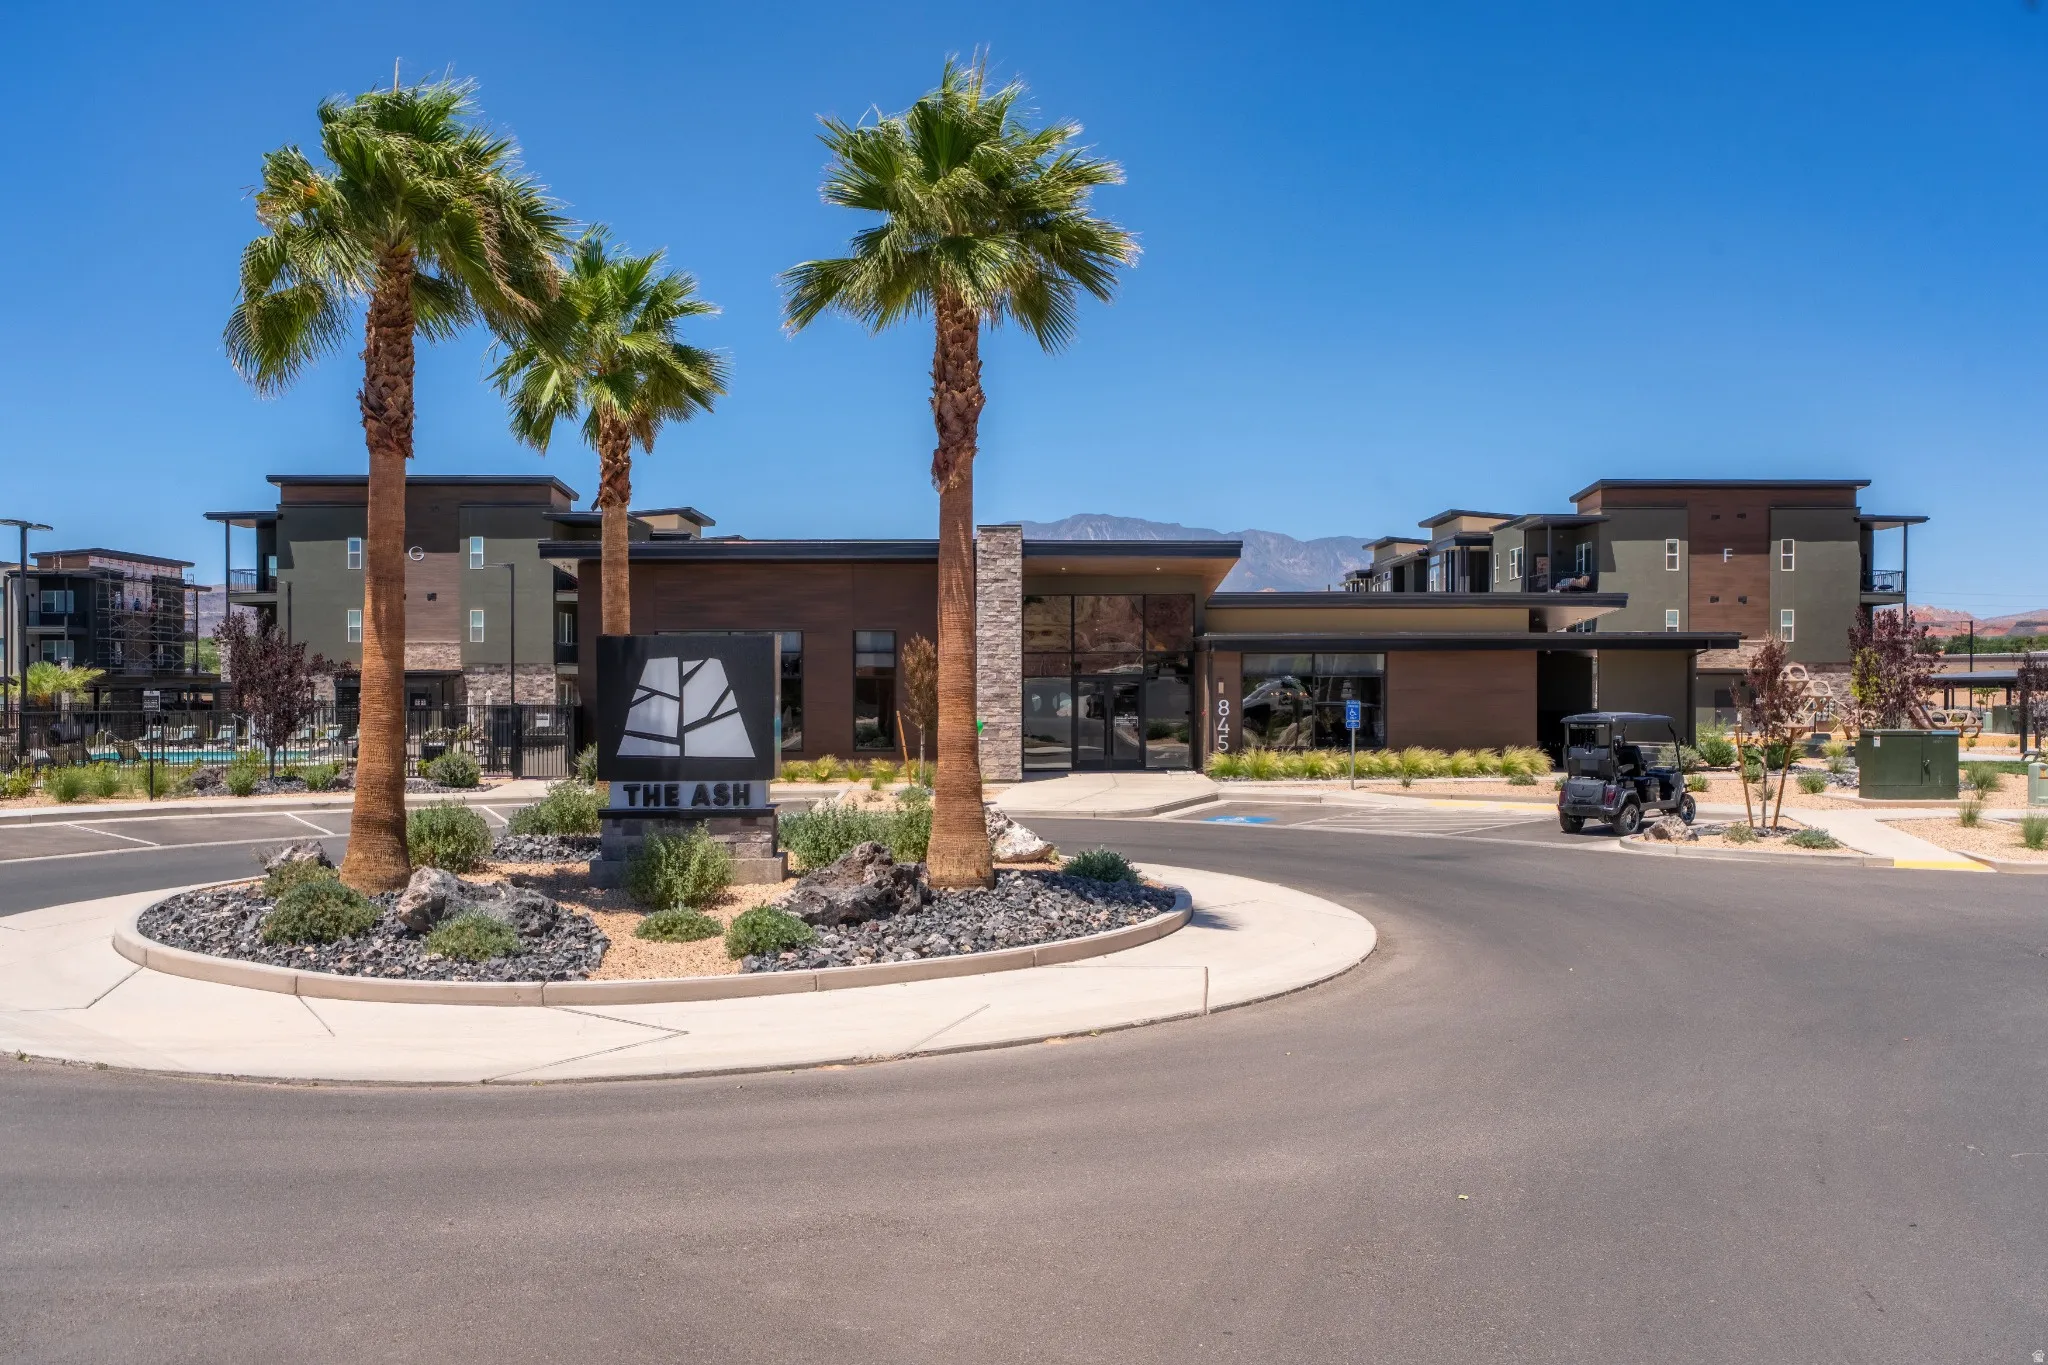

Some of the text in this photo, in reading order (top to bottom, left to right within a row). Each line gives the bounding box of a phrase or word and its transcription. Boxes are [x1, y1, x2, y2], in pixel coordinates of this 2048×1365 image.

[409, 546, 425, 561] G
[1723, 548, 1733, 562] F
[1217, 699, 1230, 751] 845
[623, 782, 750, 807] THE ASH
